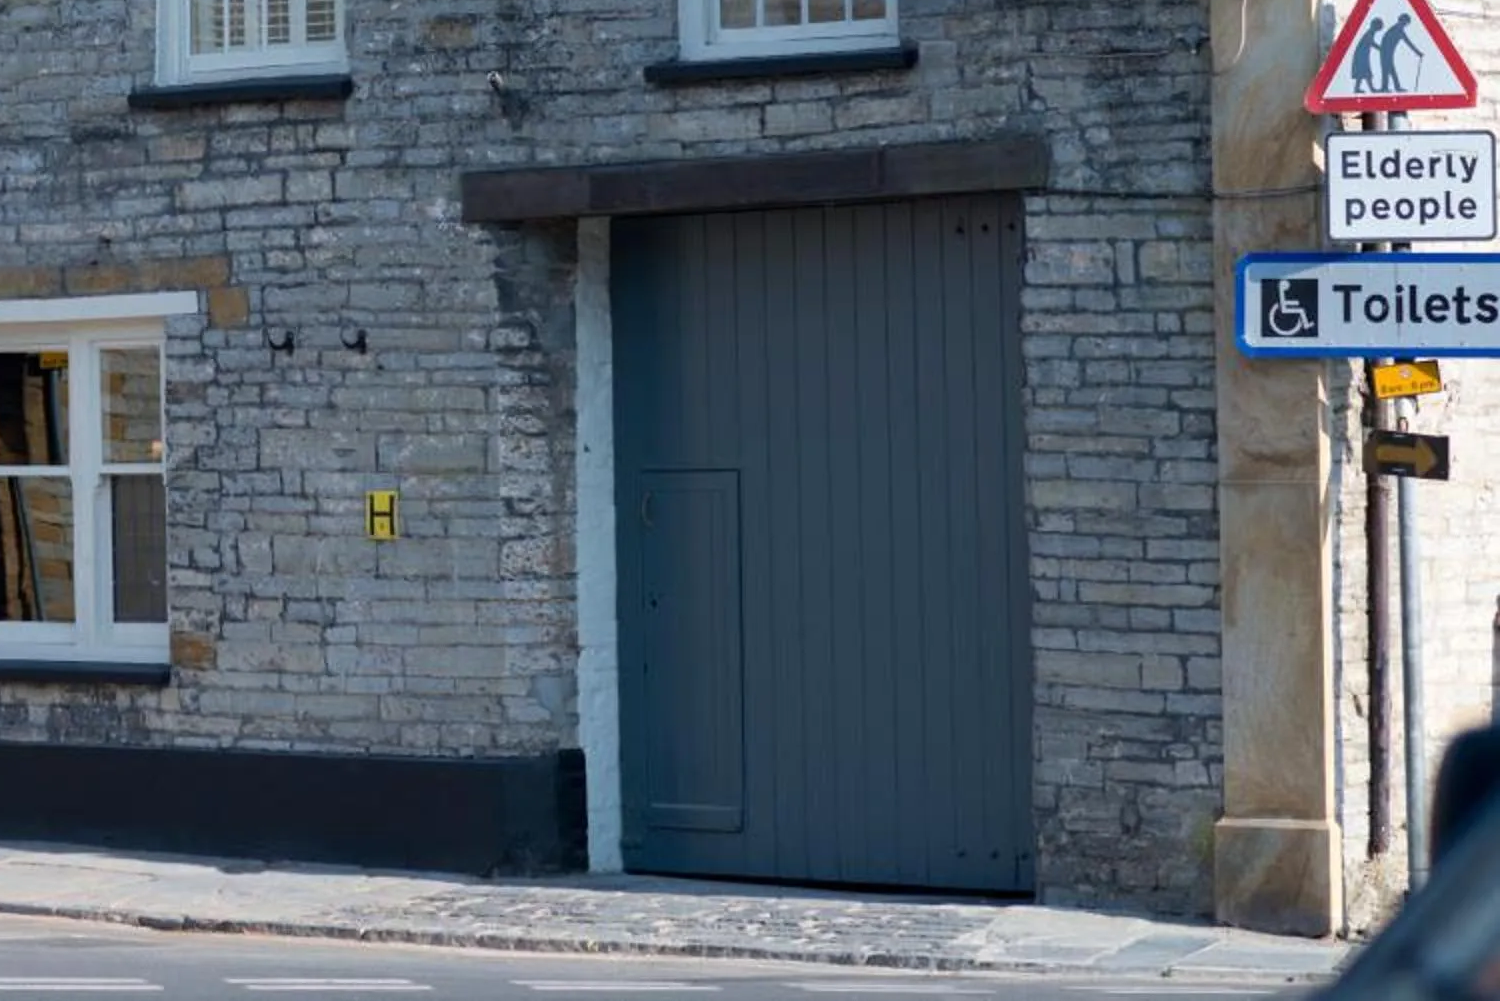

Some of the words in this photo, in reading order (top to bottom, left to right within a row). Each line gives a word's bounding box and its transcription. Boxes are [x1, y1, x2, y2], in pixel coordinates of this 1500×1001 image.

[1341, 150, 1478, 183] Elderly
[1345, 190, 1477, 226] people
[1332, 284, 1499, 324] Toilets
[370, 494, 395, 536] H
